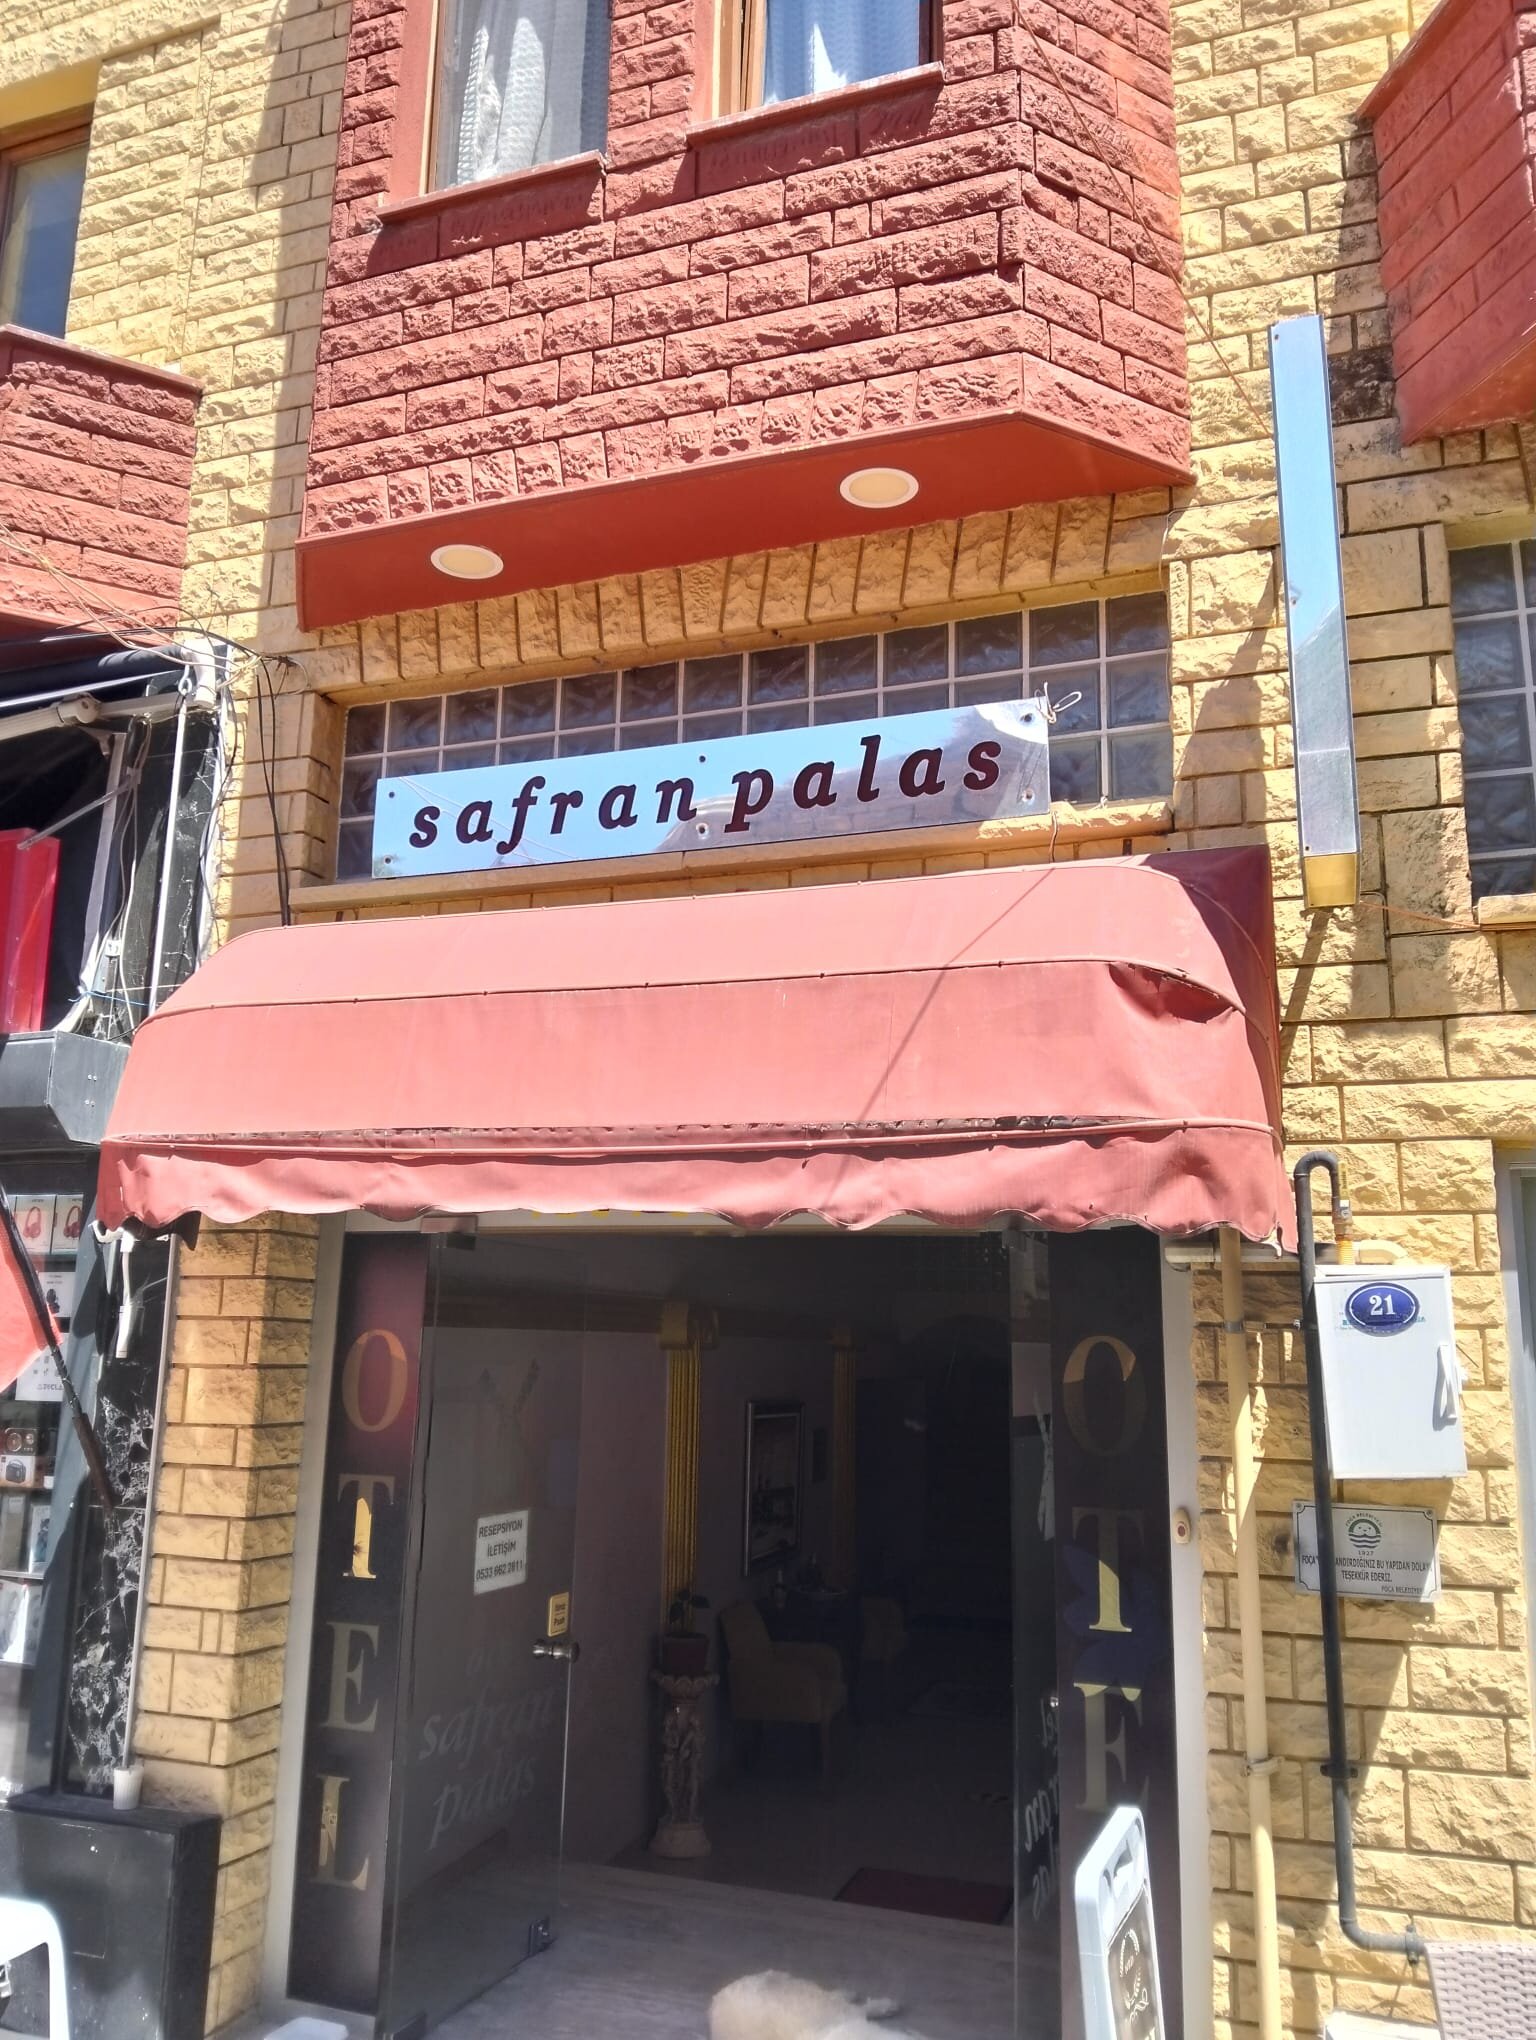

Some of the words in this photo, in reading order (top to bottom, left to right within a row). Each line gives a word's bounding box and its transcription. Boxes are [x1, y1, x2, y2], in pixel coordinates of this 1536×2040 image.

[409, 775, 698, 854] safran
[725, 734, 1004, 833] palas
[1369, 1294, 1396, 1316] 21
[478, 1519, 523, 1539] RESEPSİYON
[475, 1566, 493, 1581] 0533
[1062, 1335, 1149, 1811] OTE
[311, 1328, 409, 1891] OTEL
